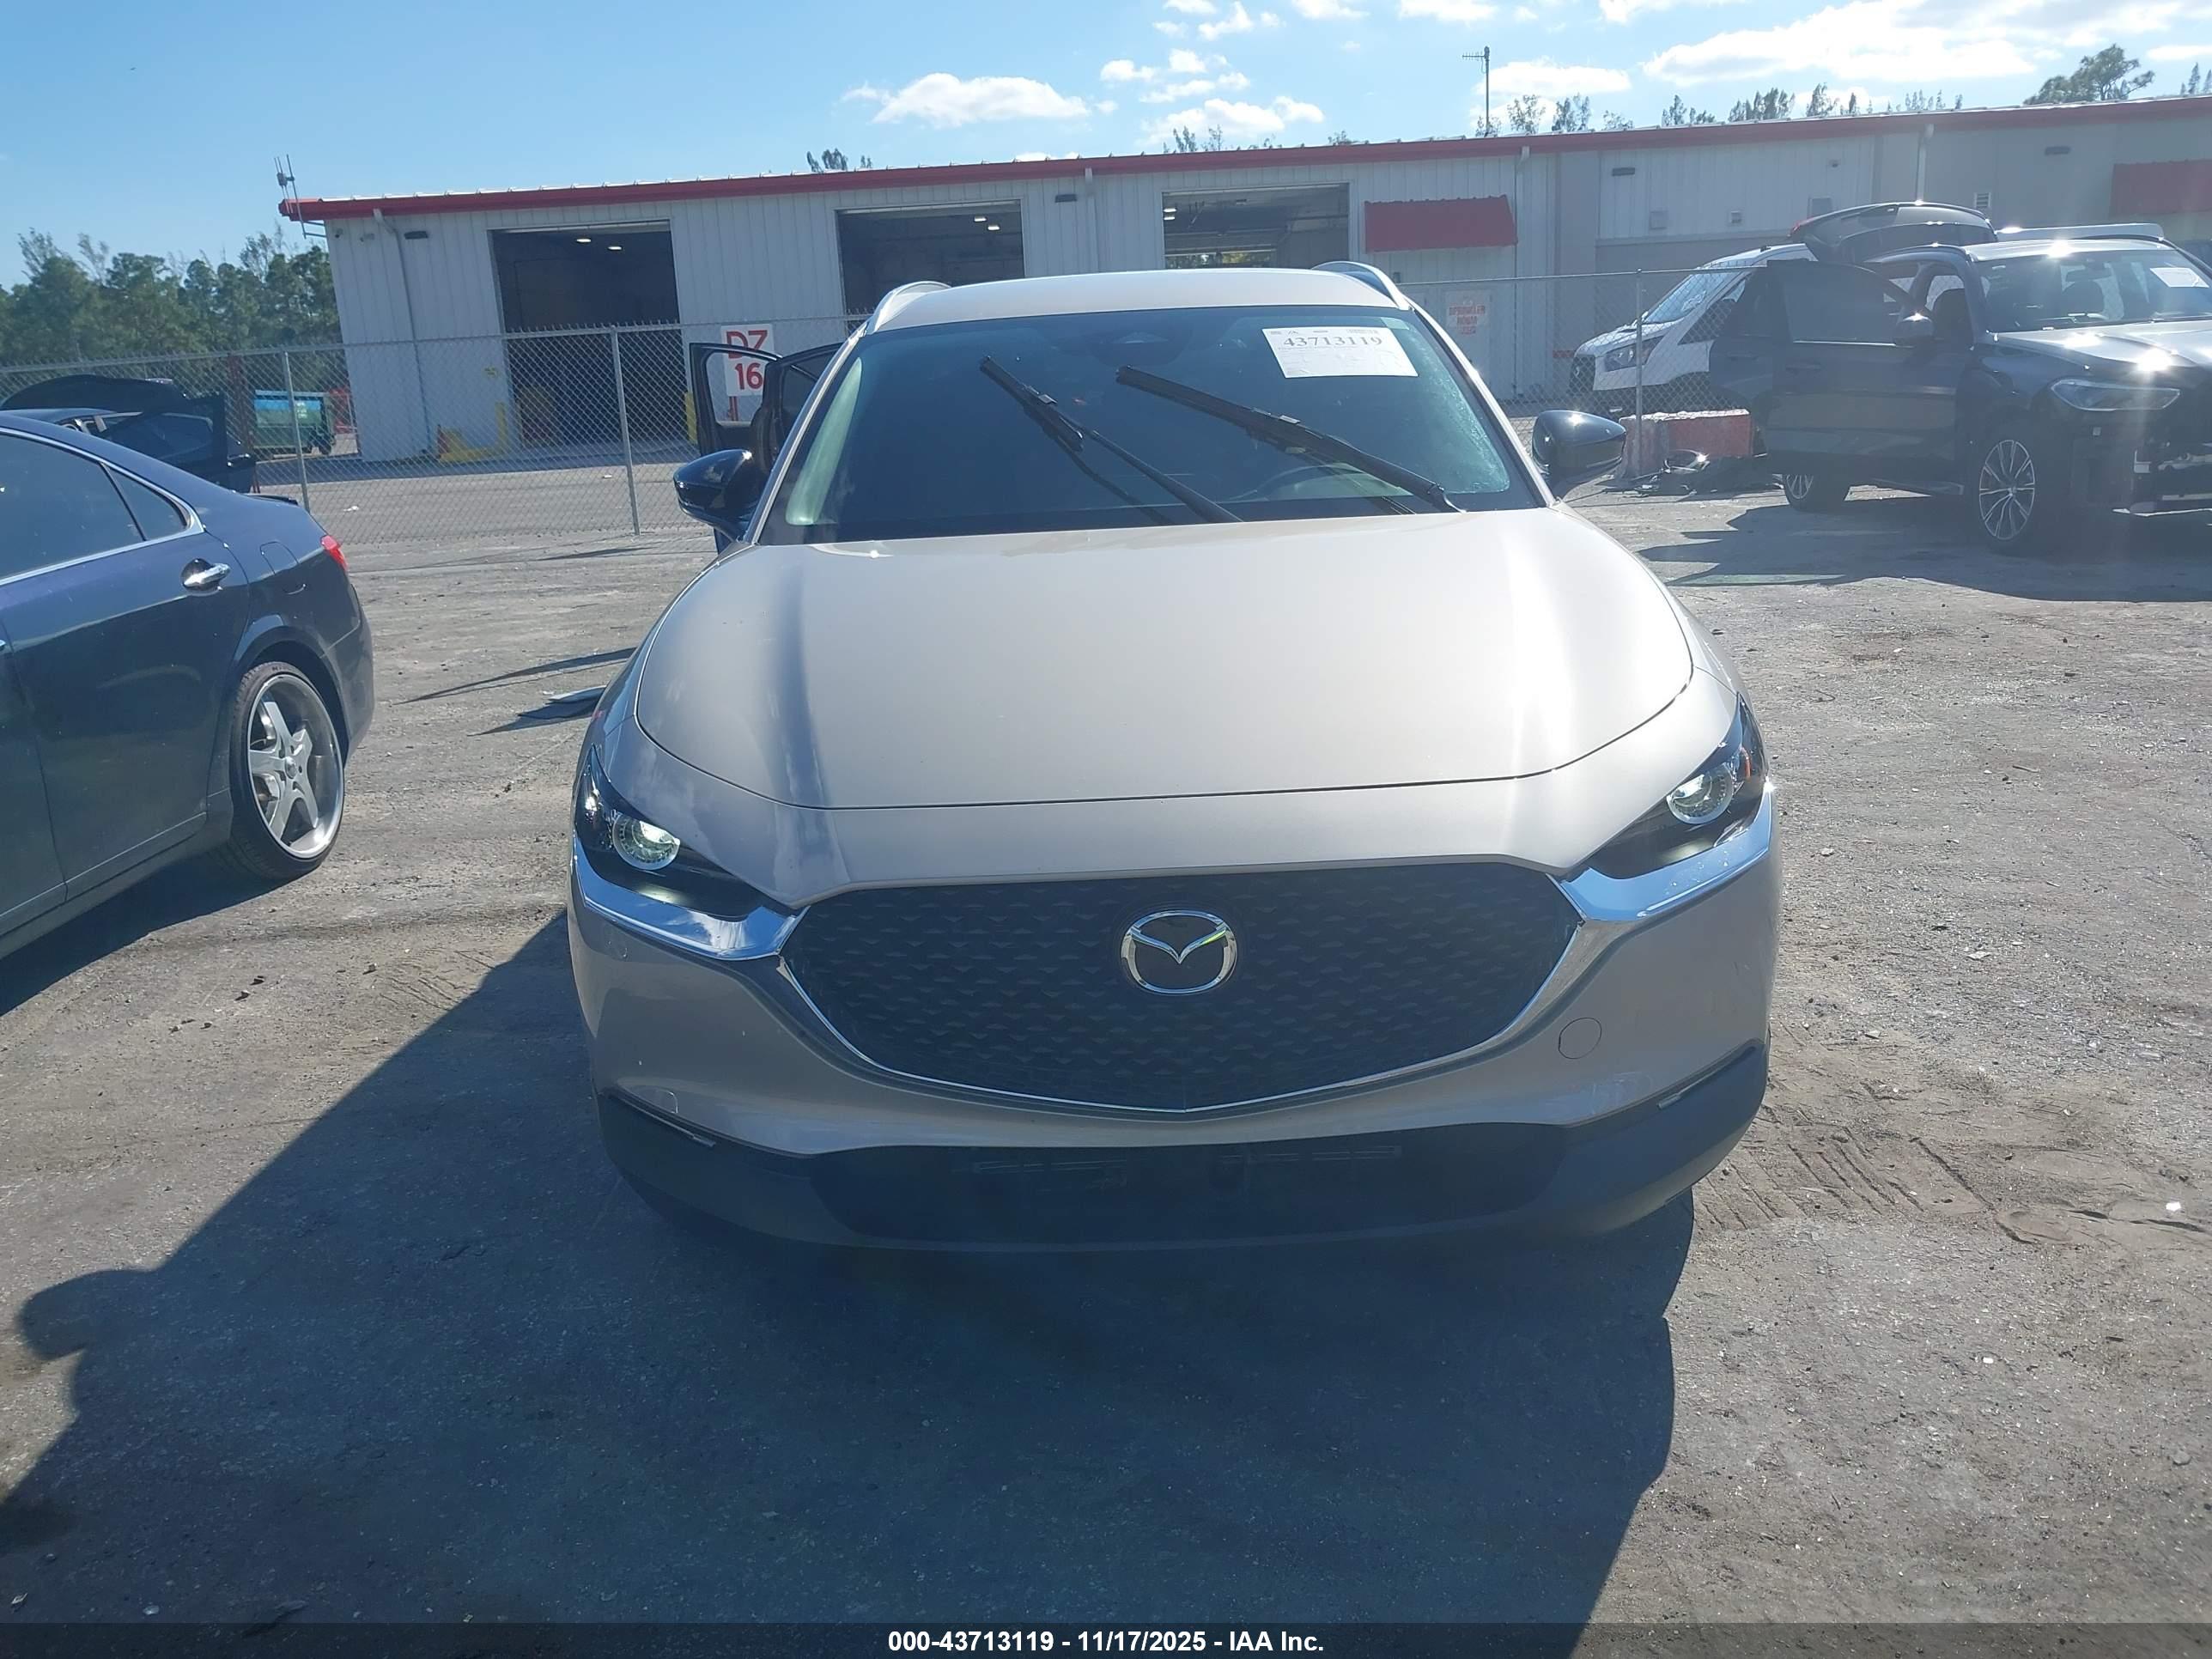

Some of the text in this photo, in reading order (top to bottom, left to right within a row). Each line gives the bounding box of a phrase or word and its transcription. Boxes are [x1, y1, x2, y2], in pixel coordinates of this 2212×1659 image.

[726, 330, 768, 359] D7
[1284, 336, 1382, 347] 43713119
[735, 362, 763, 390] 16
